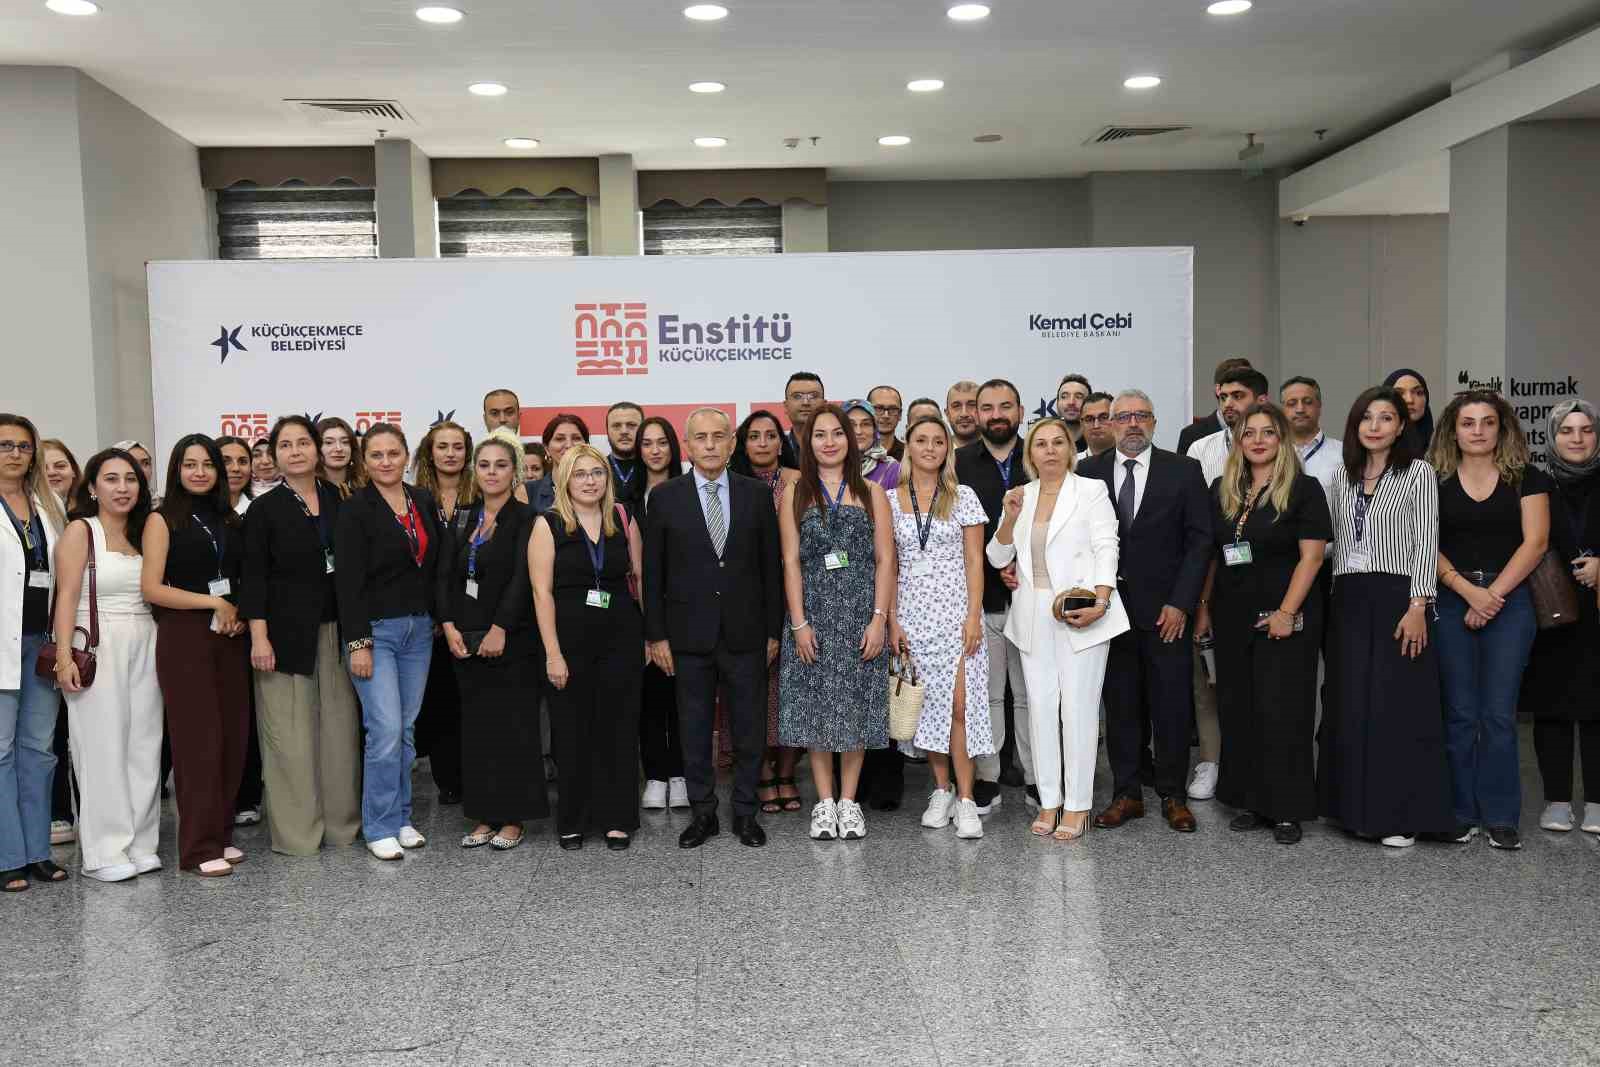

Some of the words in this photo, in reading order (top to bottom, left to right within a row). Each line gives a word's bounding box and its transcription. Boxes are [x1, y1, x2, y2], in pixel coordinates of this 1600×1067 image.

[658, 312, 792, 345] Enstitü
[1029, 313, 1087, 331] Kemal
[1090, 312, 1132, 331] Çebi
[251, 324, 363, 338] KÜÇÜKÇEKMECE
[271, 337, 346, 352] BELEDİYESİ
[659, 347, 792, 363] KÜÇÜKÇEKMECE
[1510, 376, 1578, 397] kurmak
